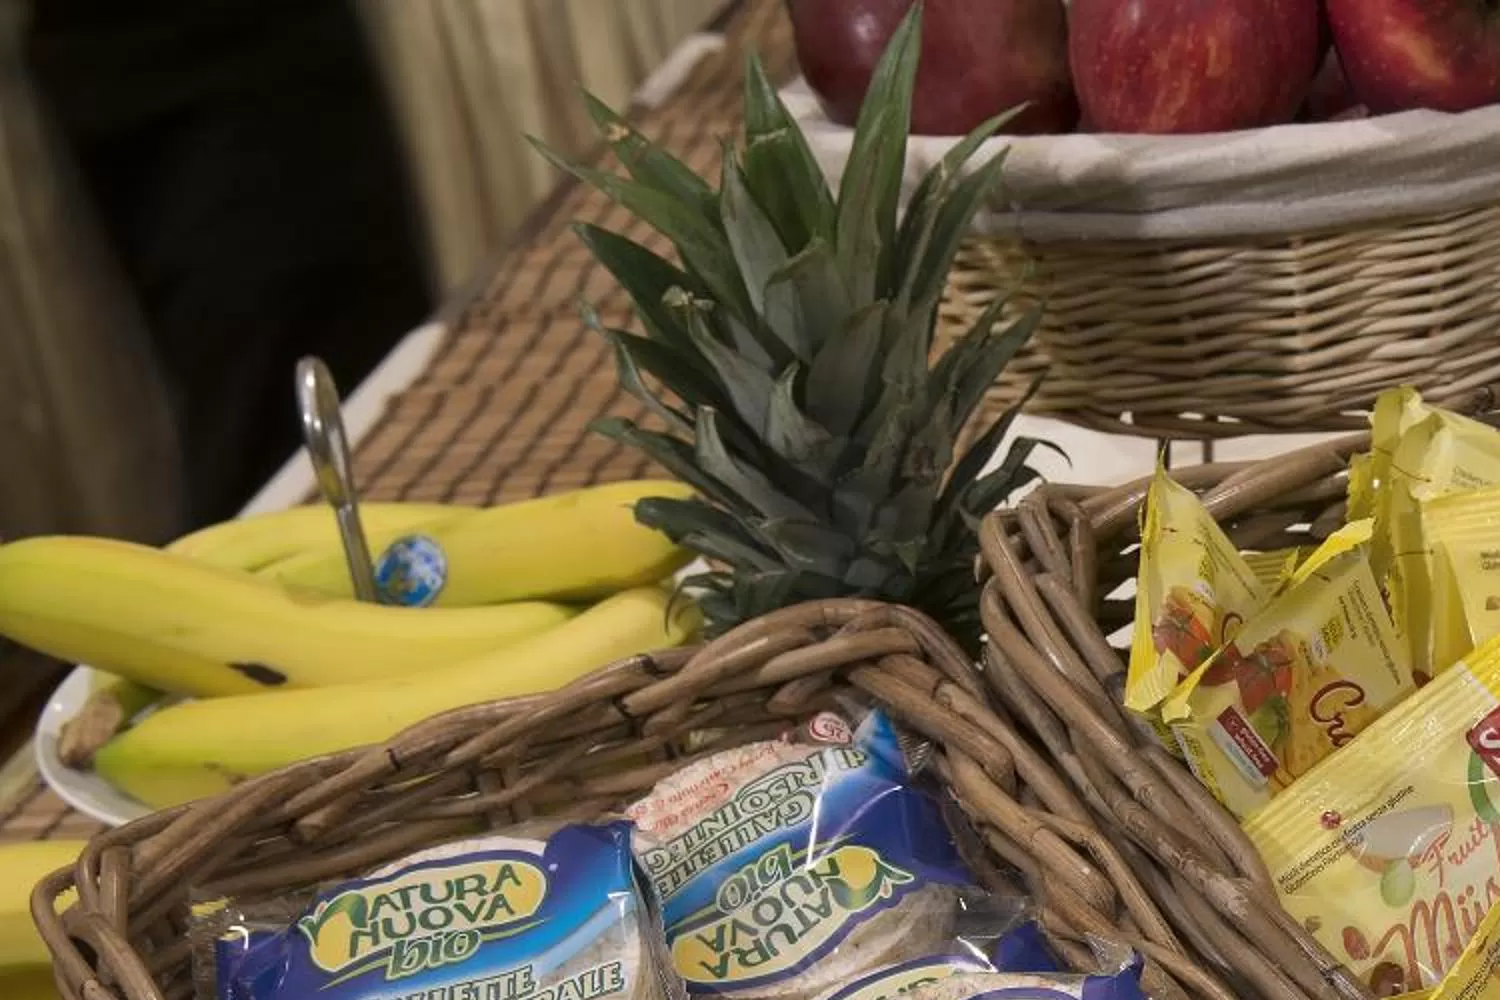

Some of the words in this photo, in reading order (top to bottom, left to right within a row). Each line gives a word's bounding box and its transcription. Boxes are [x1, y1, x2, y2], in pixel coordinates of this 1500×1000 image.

[640, 802, 736, 872] INTEG
[654, 792, 813, 897] GALLETTE
[1423, 819, 1490, 888] Fruit
[303, 864, 521, 943] NATURA
[696, 857, 840, 951] NUOVA
[717, 845, 790, 914] bio
[349, 893, 516, 957] NUOVA
[386, 929, 479, 980] bio
